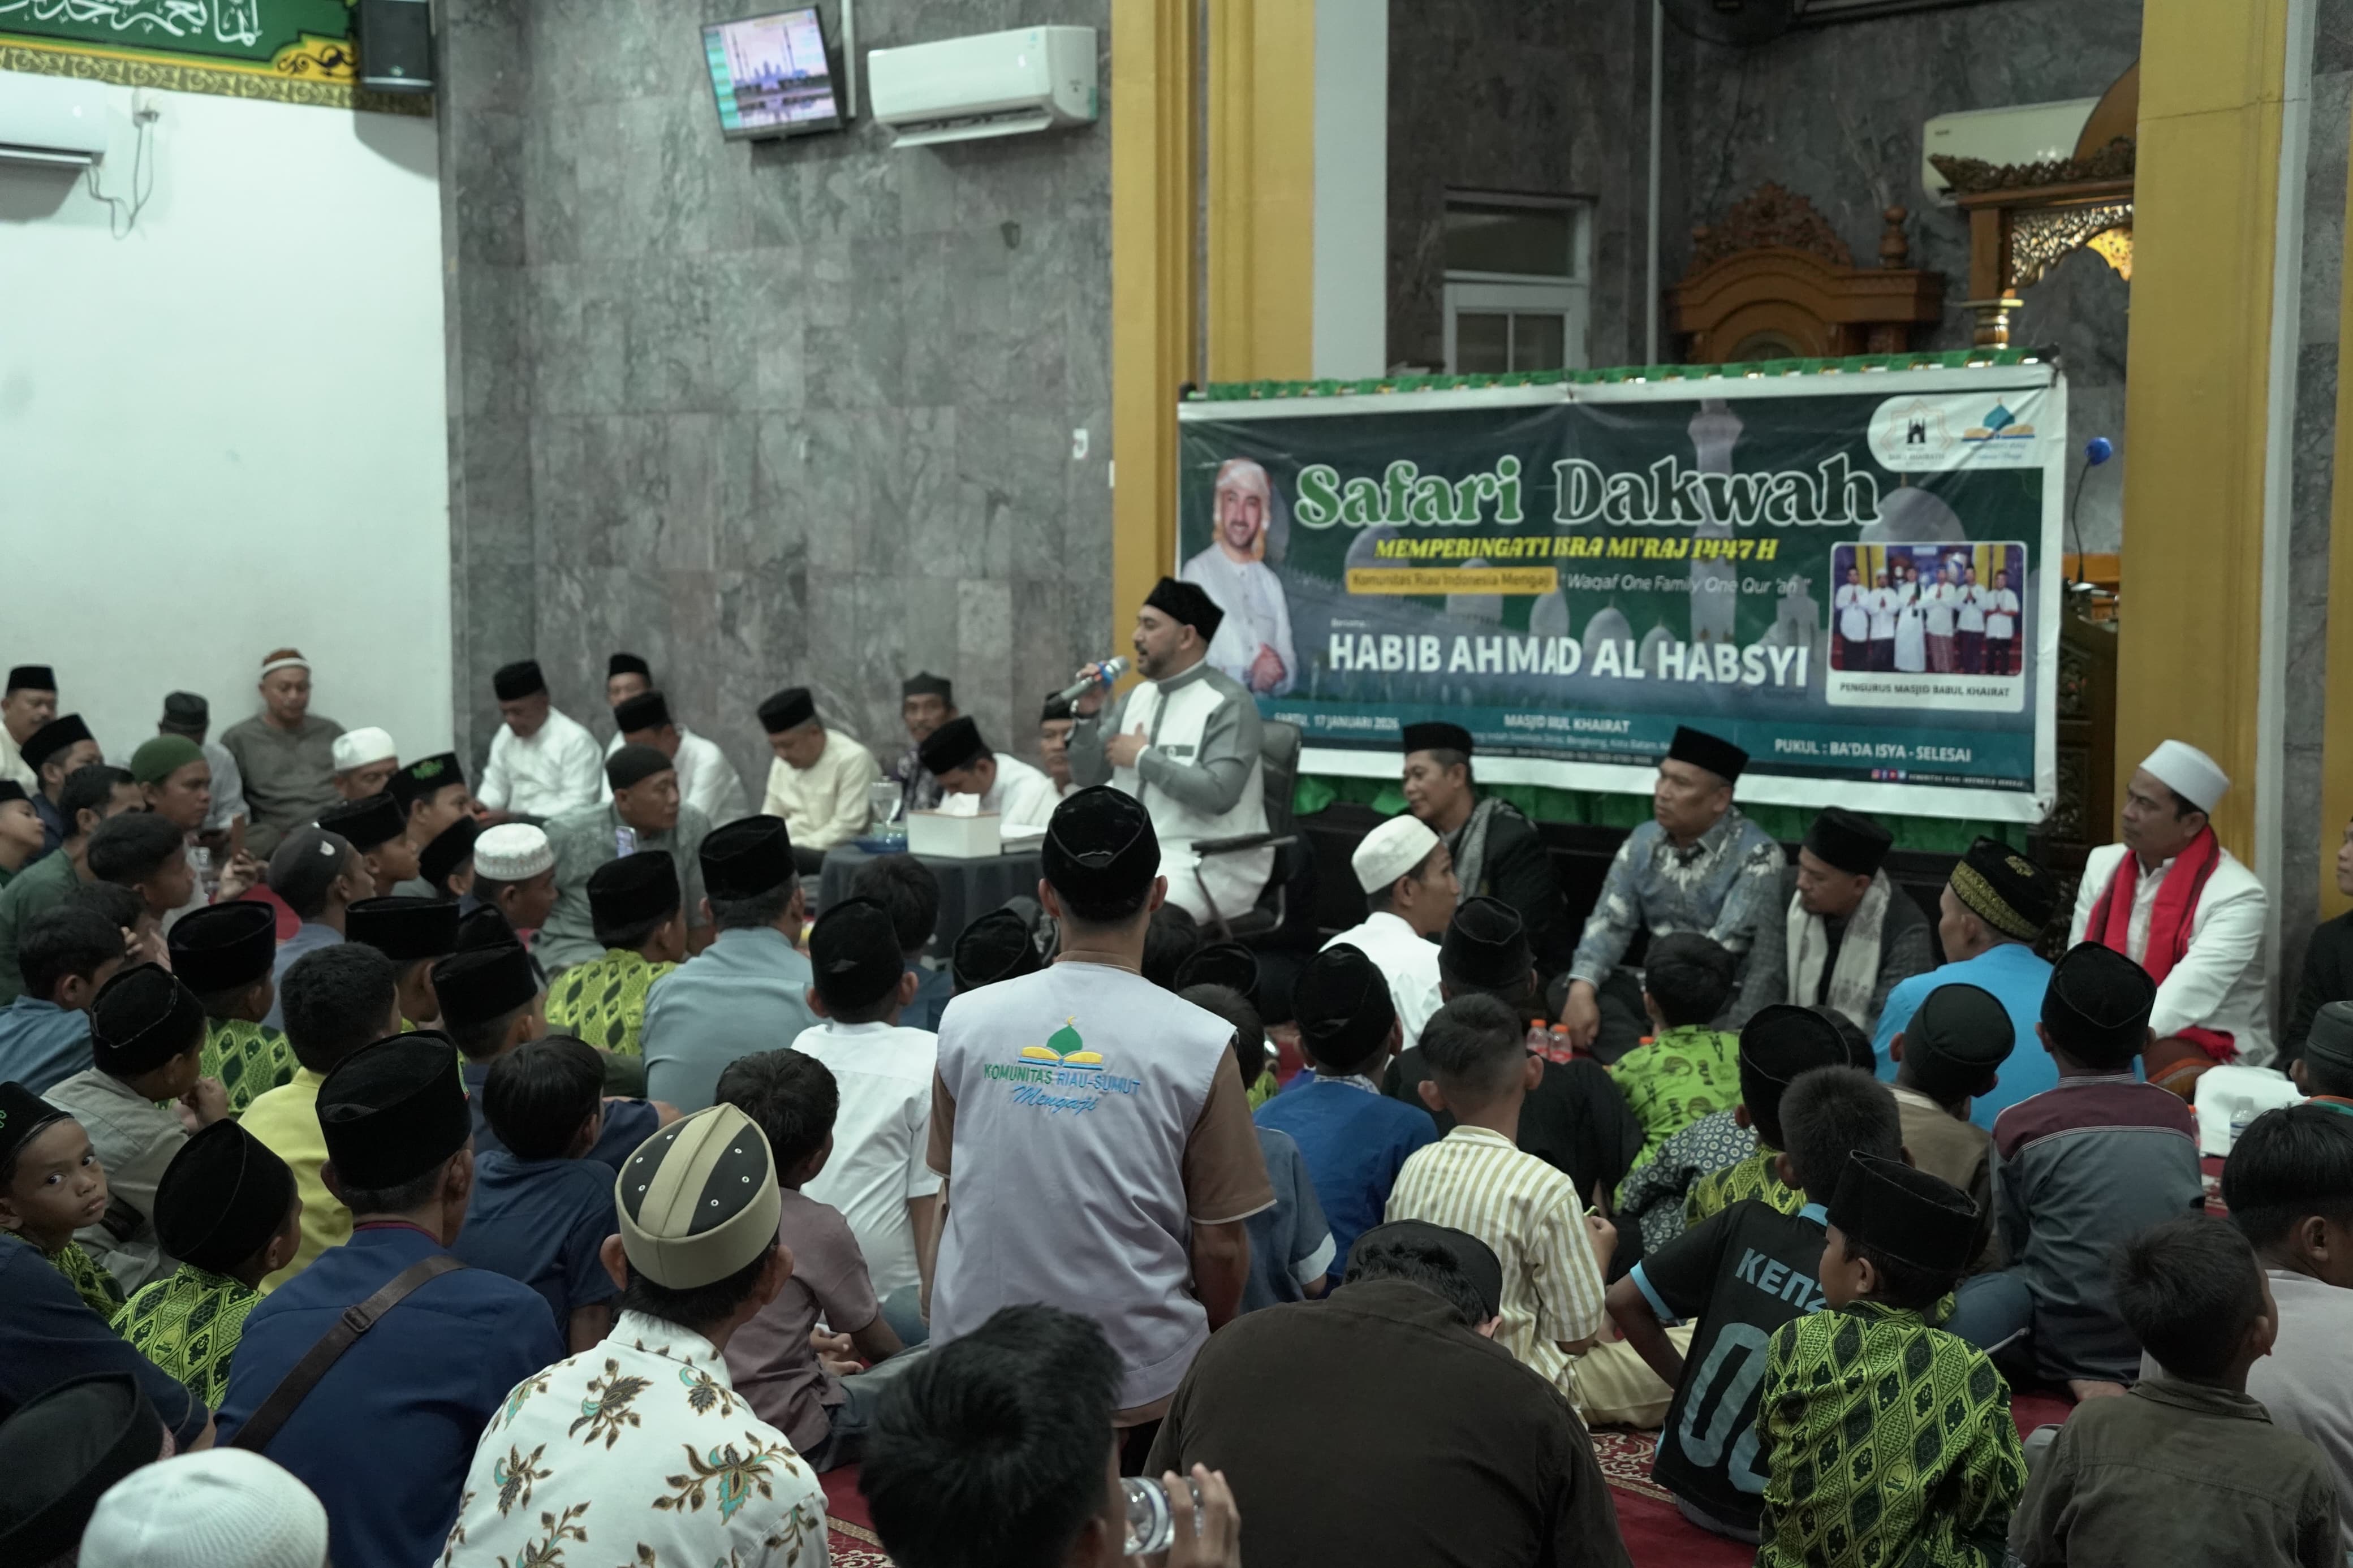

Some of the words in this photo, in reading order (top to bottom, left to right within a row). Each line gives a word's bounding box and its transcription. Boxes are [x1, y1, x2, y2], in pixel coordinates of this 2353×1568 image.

[1294, 454, 1524, 529] Safari
[1553, 452, 1882, 526] Dakwah
[1374, 536, 1551, 558] MEMPERINGATI
[1552, 537, 1603, 558] ISRA
[1606, 537, 1690, 559] MI'RAJ
[1756, 539, 1779, 560] H
[1621, 574, 1652, 591] One
[1705, 576, 1738, 594] One
[1329, 633, 1441, 672] HABIB
[1447, 635, 1582, 676] AHMAD
[1591, 638, 1645, 678] AL
[1657, 641, 1809, 688] HABSYI
[1840, 682, 1892, 693] PENGURUS
[1894, 683, 1930, 697] MASJID
[1932, 685, 1964, 696] BABUL
[1966, 686, 2011, 698] KHAIRAT
[1775, 738, 1820, 755] PUKUL
[1830, 741, 1873, 758] BA'DA
[1875, 743, 1907, 759] ISYA
[1916, 746, 1972, 763] SELESAI
[984, 1064, 1053, 1085] KOMUNITAS
[1057, 1072, 1140, 1095] RIAU-SUMUT
[1013, 1085, 1098, 1115] Mengaji
